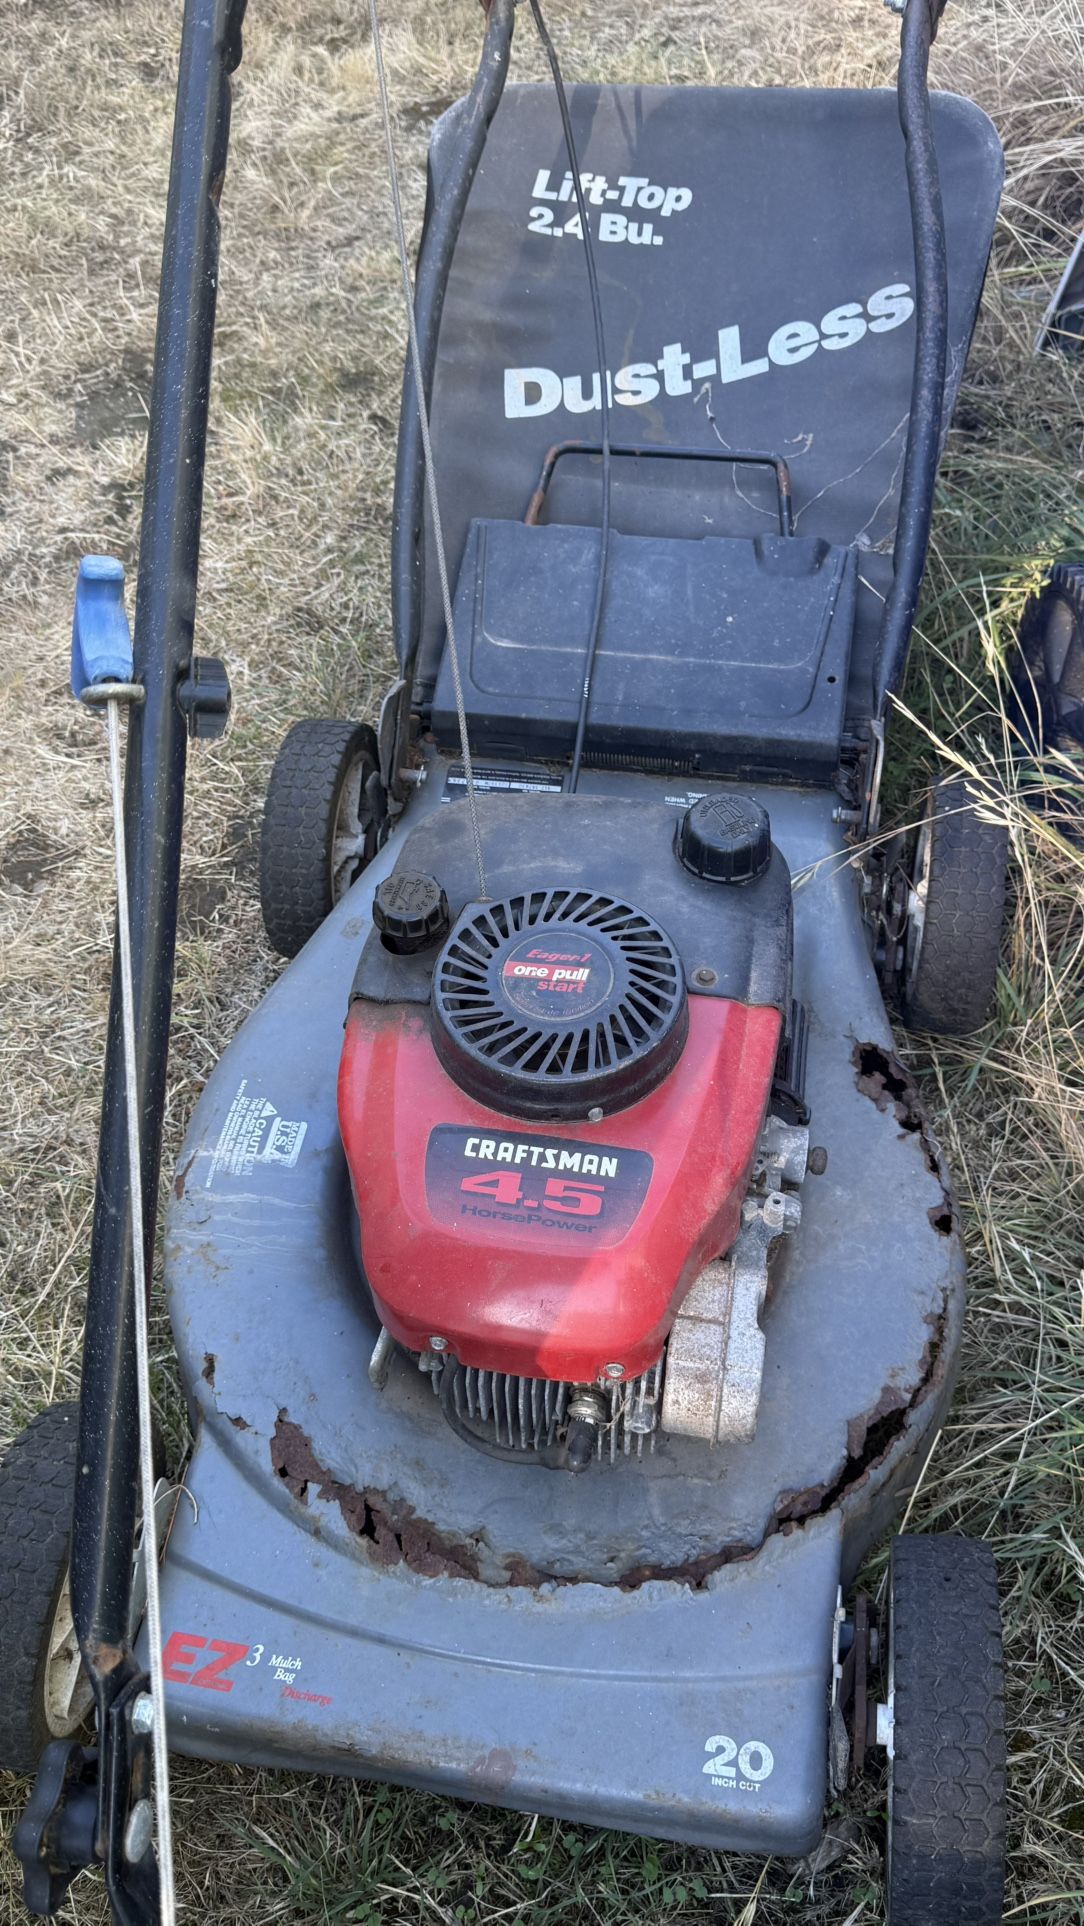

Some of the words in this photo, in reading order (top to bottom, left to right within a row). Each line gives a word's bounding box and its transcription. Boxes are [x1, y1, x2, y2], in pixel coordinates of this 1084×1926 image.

[531, 169, 693, 217] Lift-Top
[528, 206, 591, 240] 2.4
[599, 213, 663, 245] Bu.
[504, 283, 915, 418] Dust-Less
[514, 965, 549, 977] one
[552, 968, 590, 981] pull
[537, 981, 586, 993] start
[234, 1079, 247, 1099] SAFETY
[248, 1098, 258, 1109] THE
[255, 1097, 266, 1109] THE
[238, 1112, 252, 1134] ENGINE
[246, 1110, 260, 1131] BLADE
[240, 1119, 266, 1175] CAUTION
[283, 1122, 301, 1151] MADE
[464, 1137, 618, 1178] CRAFTSMAN
[460, 1170, 605, 1217] 4.5
[461, 1203, 598, 1234] HorsePower
[268, 1654, 302, 1671] Mulch
[273, 1668, 296, 1684] Bag
[281, 1685, 334, 1708] Discharge
[702, 1734, 774, 1782] 20
[711, 1776, 736, 1789] INCH
[739, 1780, 761, 1792] CUT
